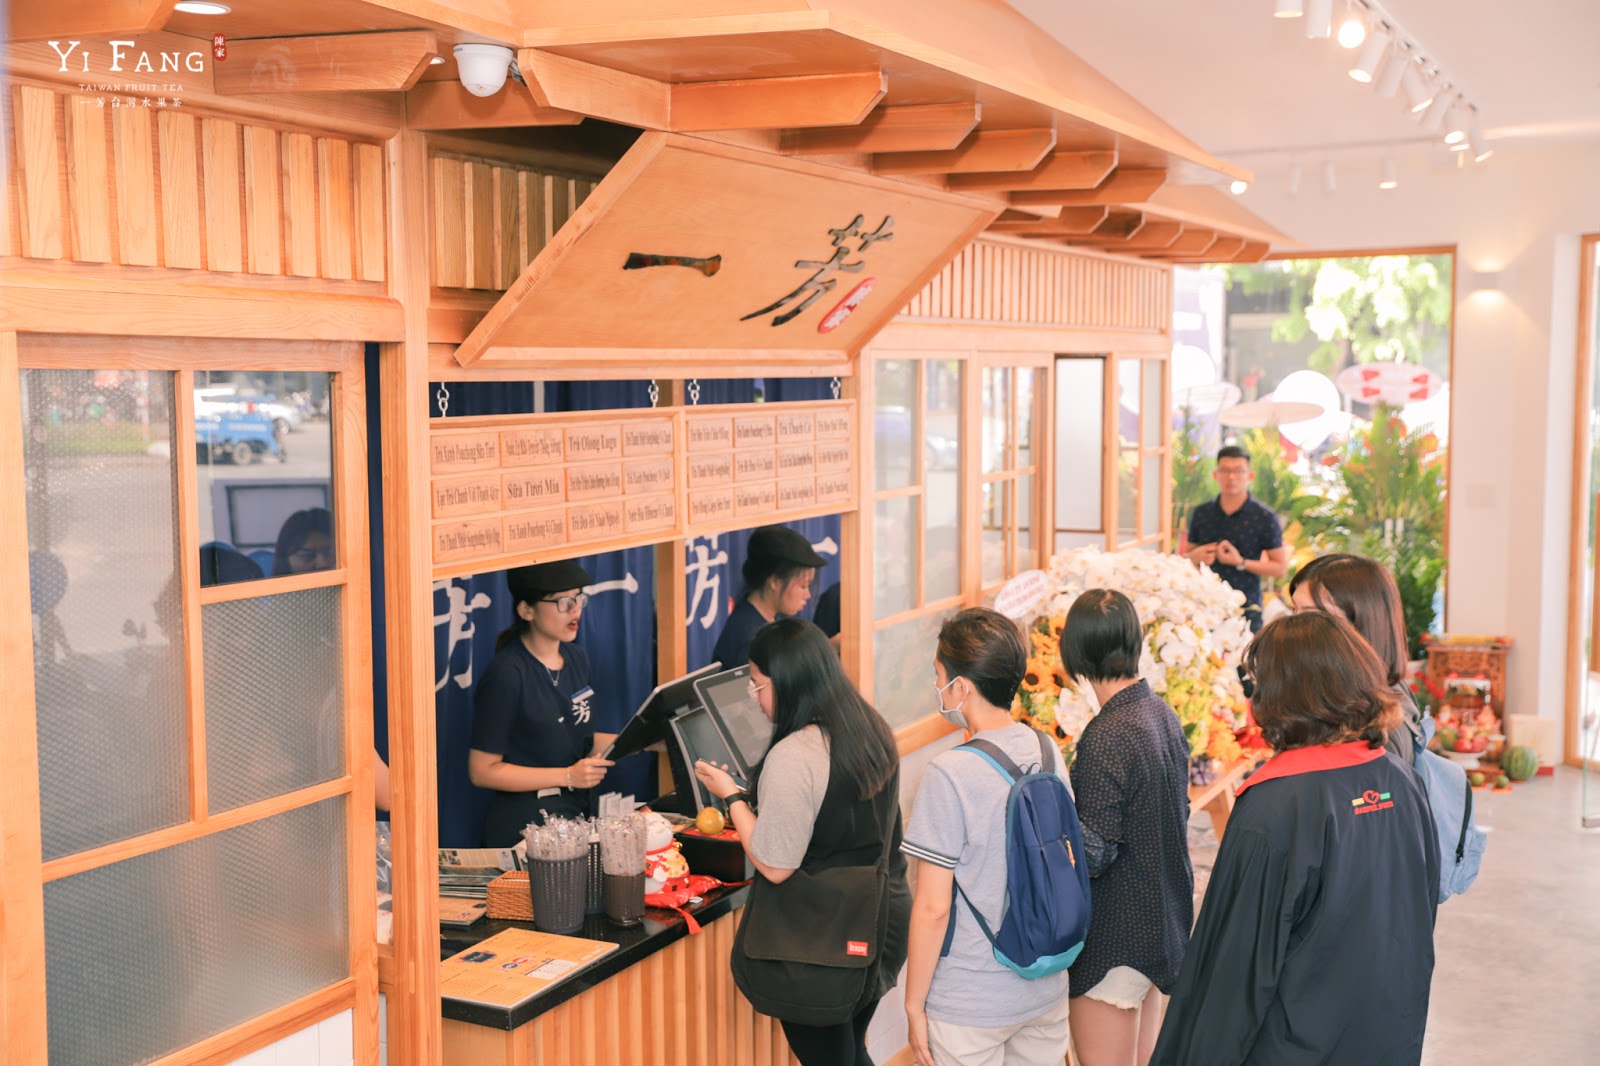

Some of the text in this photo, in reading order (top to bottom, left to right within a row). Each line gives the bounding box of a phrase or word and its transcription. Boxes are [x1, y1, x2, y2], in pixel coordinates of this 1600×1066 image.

[508, 483, 523, 499] Sữa
[525, 480, 543, 497] Tươi
[545, 478, 560, 495] Mía
